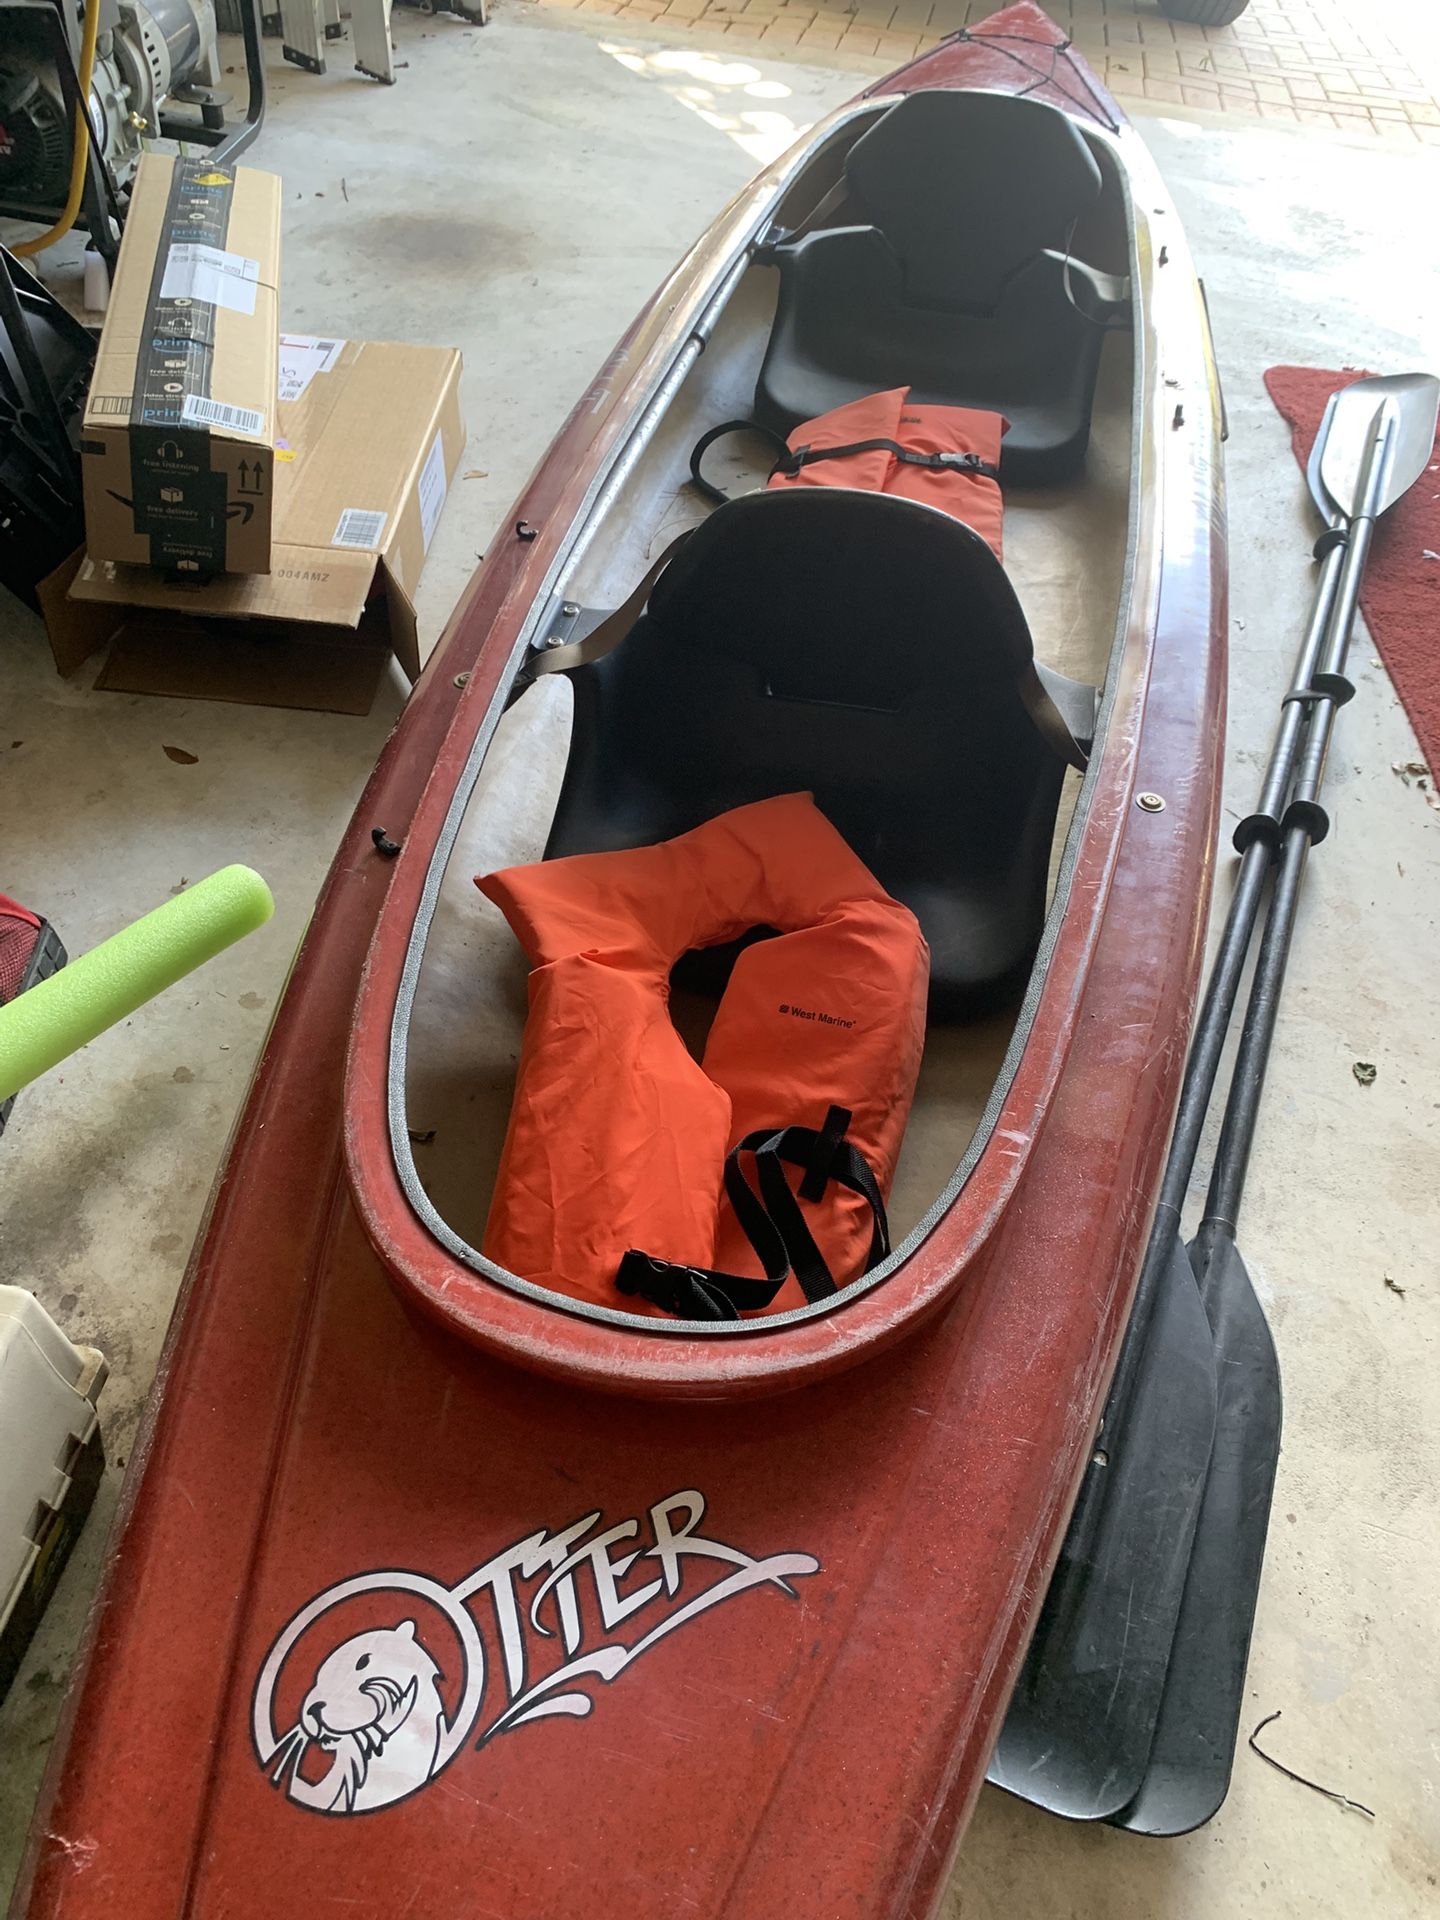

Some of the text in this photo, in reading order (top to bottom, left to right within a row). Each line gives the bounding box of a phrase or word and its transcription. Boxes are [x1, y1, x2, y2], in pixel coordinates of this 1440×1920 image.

[144, 406, 182, 420] prim
[277, 568, 330, 583] 004AMZ
[791, 1006, 855, 1028] West Marine
[251, 1490, 816, 1816] OTTER
